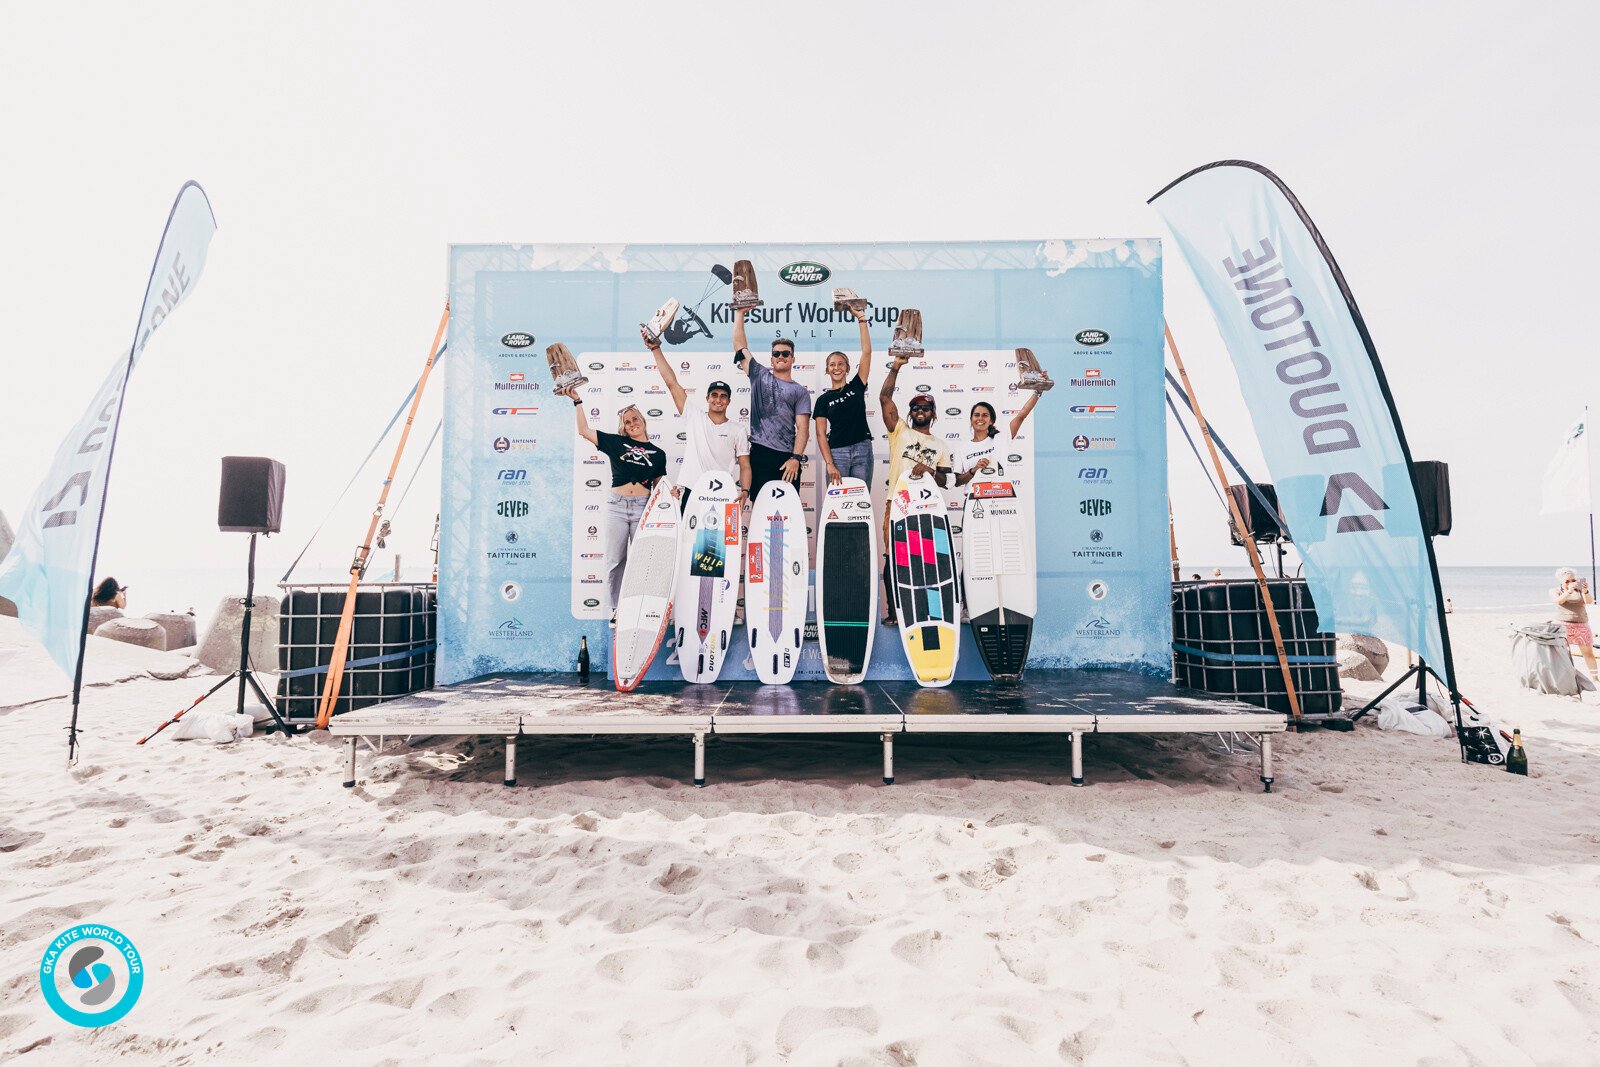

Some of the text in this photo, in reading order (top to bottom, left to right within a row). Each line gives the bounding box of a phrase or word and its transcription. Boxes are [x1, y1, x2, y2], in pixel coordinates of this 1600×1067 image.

[788, 265, 815, 274] LAND
[790, 273, 824, 282] ROVER
[494, 382, 540, 391] Müllermilch
[1070, 379, 1116, 387] Müllermilch
[497, 469, 527, 480] ran
[1078, 467, 1108, 479] ran
[497, 500, 529, 517] JEVER
[1079, 499, 1112, 517] JEVER
[694, 552, 724, 568] WHIP
[700, 607, 708, 629] MFC
[708, 632, 717, 672] DUOTONE
